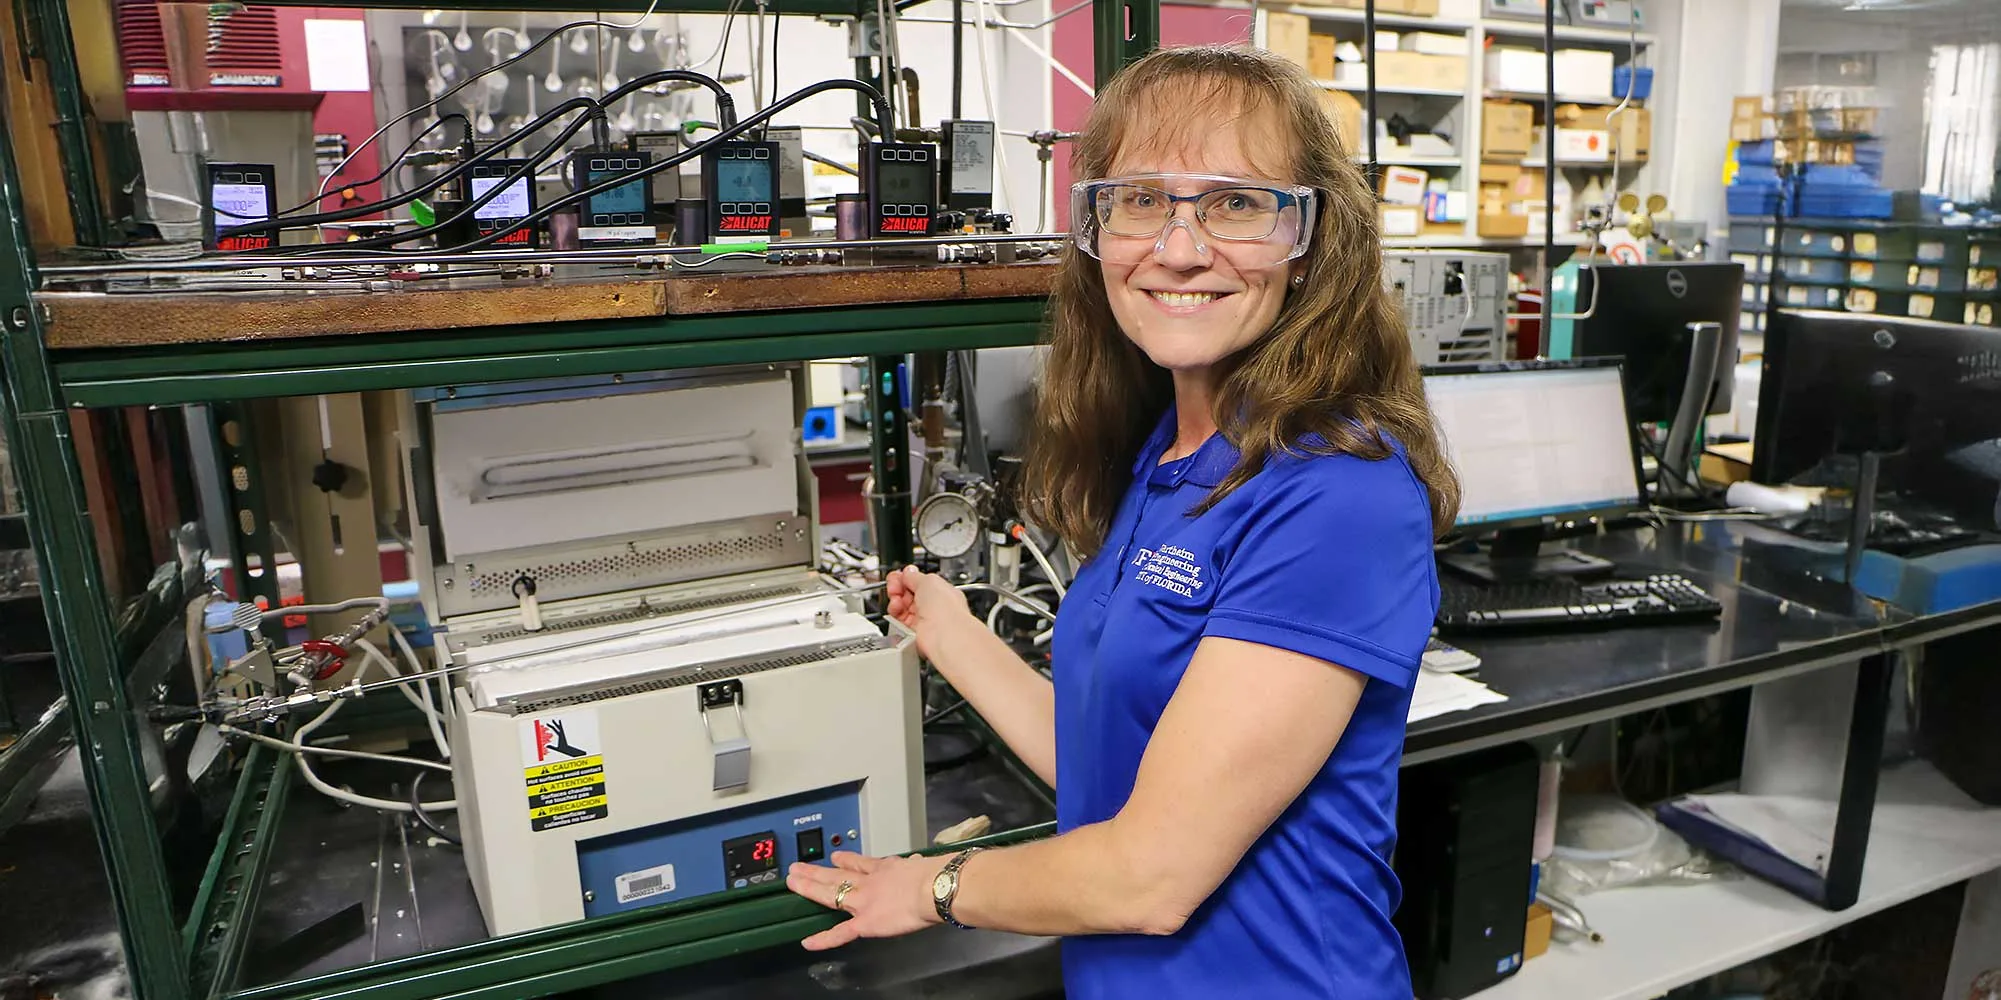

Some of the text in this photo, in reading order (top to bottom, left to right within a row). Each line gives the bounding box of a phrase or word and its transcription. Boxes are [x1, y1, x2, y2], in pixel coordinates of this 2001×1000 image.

[733, 216, 772, 230] ALICAT
[892, 217, 930, 230] ALICAT
[1151, 574, 1193, 598] FLORIDA
[552, 760, 588, 771] CAUTION
[539, 774, 563, 783] surfaces
[564, 770, 580, 778] avoid
[580, 766, 602, 775] contact
[550, 776, 594, 790] ATTENTION
[540, 786, 593, 801] Surfaces chaudes
[554, 794, 578, 803] touchez
[549, 798, 601, 813] PRECAUCION
[580, 813, 597, 821] tocar
[793, 813, 823, 826] POWER
[752, 839, 775, 860] 23
